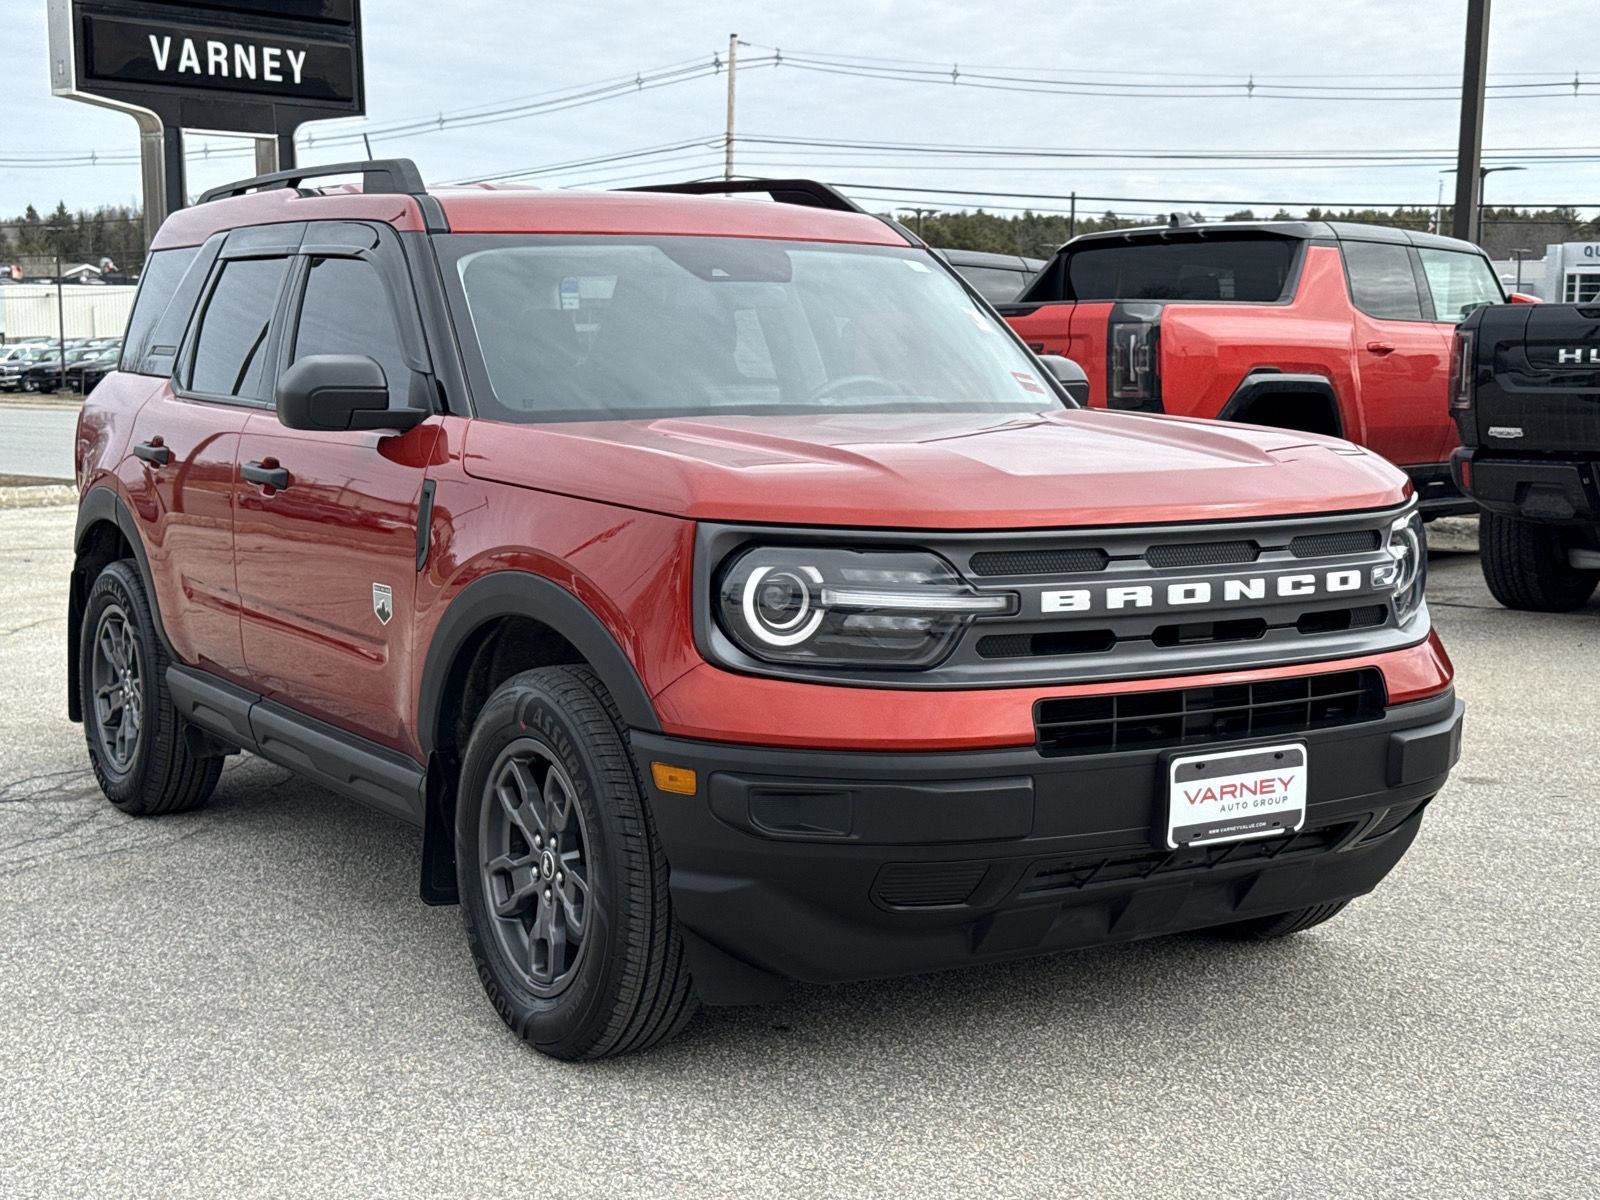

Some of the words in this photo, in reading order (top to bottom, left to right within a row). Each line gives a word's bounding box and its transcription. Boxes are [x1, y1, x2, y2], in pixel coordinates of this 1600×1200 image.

[149, 35, 306, 84] VARNEY
[1041, 570, 1361, 613] BRONCO
[1184, 775, 1295, 805] VARNEY
[1220, 801, 1248, 813] AUTO
[1253, 796, 1289, 808] GROUP
